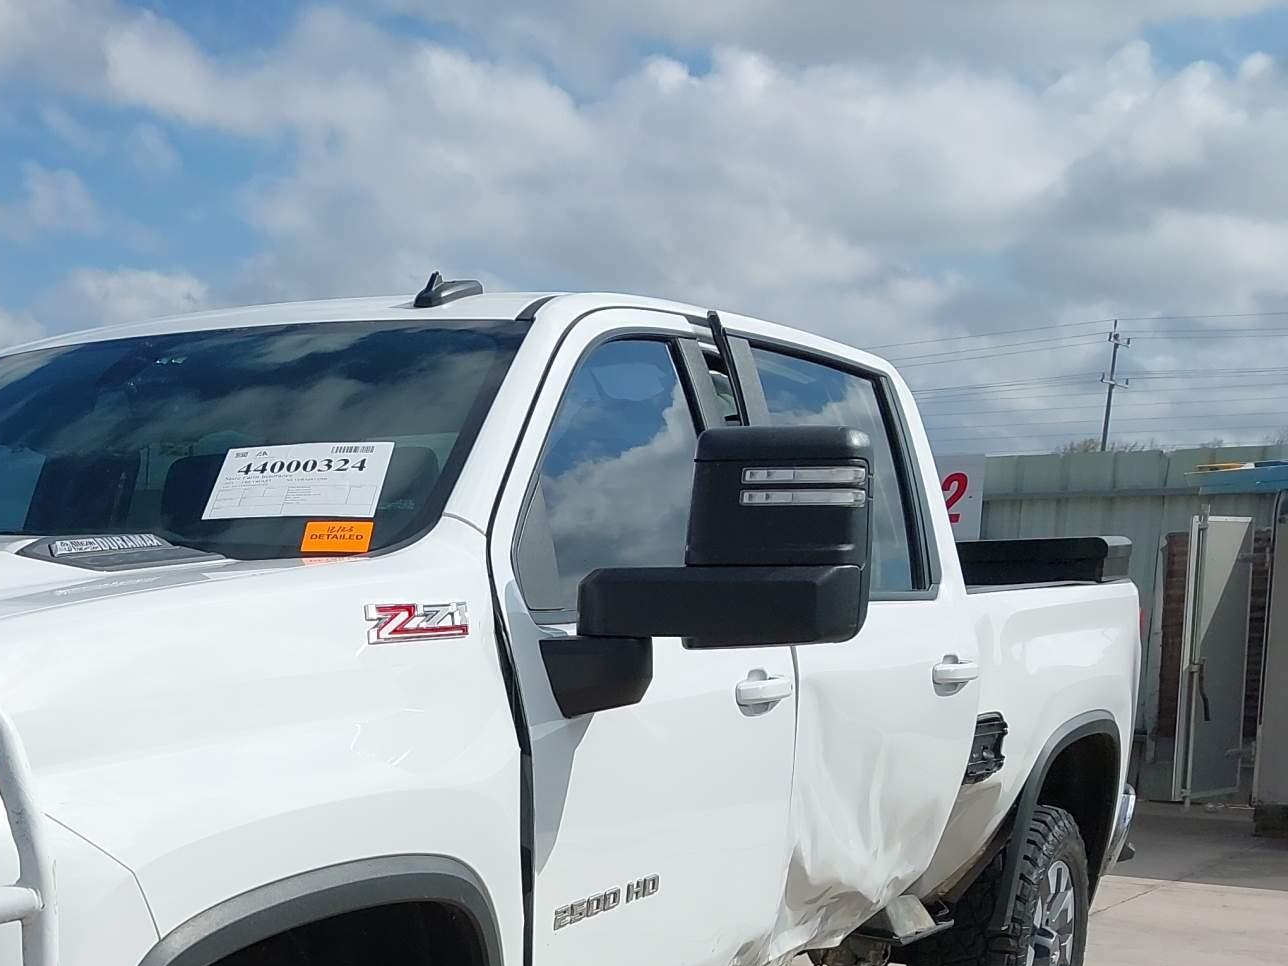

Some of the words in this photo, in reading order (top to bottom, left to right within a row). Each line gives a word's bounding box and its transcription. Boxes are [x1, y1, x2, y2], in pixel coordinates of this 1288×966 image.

[237, 458, 367, 475] 44000324
[942, 472, 969, 523] 2
[95, 533, 163, 550] DURAMAX
[310, 533, 364, 541] DETAILED
[364, 601, 470, 645] Z71
[553, 886, 621, 932] 2500
[625, 873, 660, 904] HD
